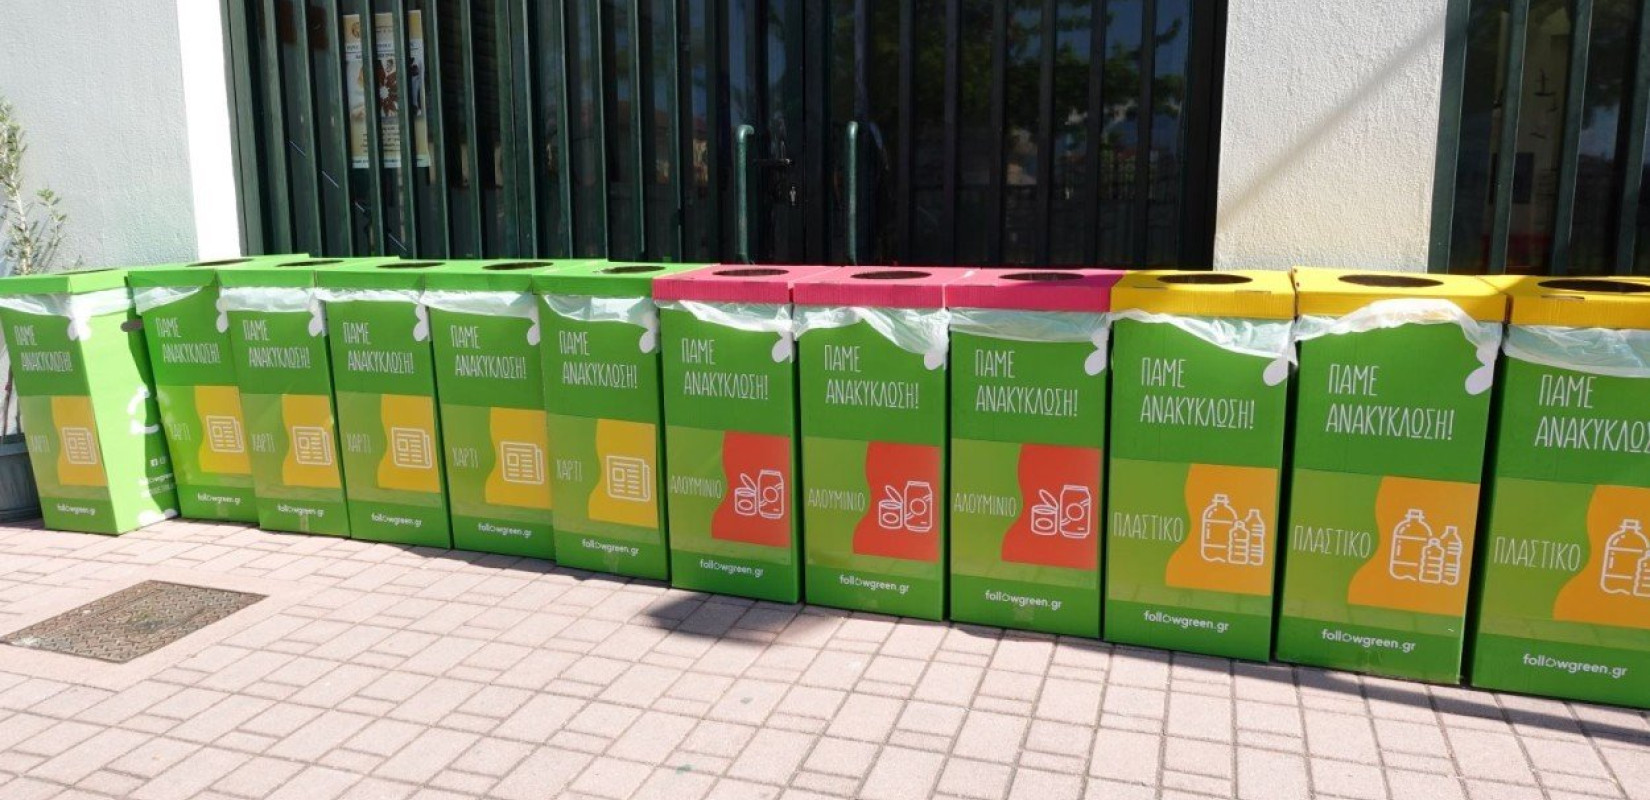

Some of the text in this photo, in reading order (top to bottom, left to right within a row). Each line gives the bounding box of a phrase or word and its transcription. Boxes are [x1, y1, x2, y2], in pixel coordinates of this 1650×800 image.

[243, 320, 269, 340] ΠΑΜΕ
[343, 322, 371, 344] ΠΑΜΕ
[450, 325, 480, 349] ΠΑΜΕ
[559, 330, 590, 356] ΠΑΜΕ
[682, 338, 715, 365] ΠΑΜΕ
[348, 351, 414, 374] ΑΝΑΚΥΚΛΩΣΗ!
[455, 355, 527, 379] ΑΝΑΚΥΚΛΩΣΗ!
[825, 345, 861, 372] ΠΑΜΕ
[975, 349, 1015, 379] ΠΑΜΕ
[562, 361, 638, 389] ΑΝΑΚΥΚΛΩΣΗ!
[1141, 358, 1186, 388] ΠΑΜΕ
[1328, 364, 1380, 396] ΠΑΜΕ
[684, 372, 768, 400] ΑΝΑΚΥΚΛΩΣΗ!
[825, 379, 919, 410] ΑΝΑΚΥΚΛΩΣΗ!
[1539, 374, 1597, 409] ΠΑΜΕ
[976, 385, 1078, 417] ΑΝΑΚΥΚΛΩΣΗ!
[1140, 395, 1255, 430] ΑΝΑΚΥΚΛΩΣΗ!
[1325, 403, 1455, 440] ΑΝΑΚΥΚΛΩΣΗ!
[556, 459, 583, 482] ΧΑΡΤΙ
[670, 475, 722, 499] ΑΛΟΥΜΙΝΙΟ
[808, 488, 864, 511] ΑΛΟΥΜΙΝΙΟ
[954, 493, 1016, 517] ΑΛΟΥΜΙΝΙΟ
[478, 523, 531, 538] followgreen.gr
[1113, 512, 1183, 543] ΠΛΑΣΤΙΚΟ
[582, 539, 639, 556] followgreen.gr
[1293, 526, 1372, 558] ΠΛΑΣΤΙΚΟ
[1494, 536, 1581, 572] ΠΛΑΣΤΙΚΟ
[700, 559, 763, 577] followgreen.gr
[839, 575, 910, 594] followgreen.gr
[985, 590, 1062, 610] followgreen.gr
[1144, 610, 1229, 632] followgreen.gr
[1322, 628, 1416, 652] followgreen.gr
[1523, 653, 1627, 678] followgreen.gr
